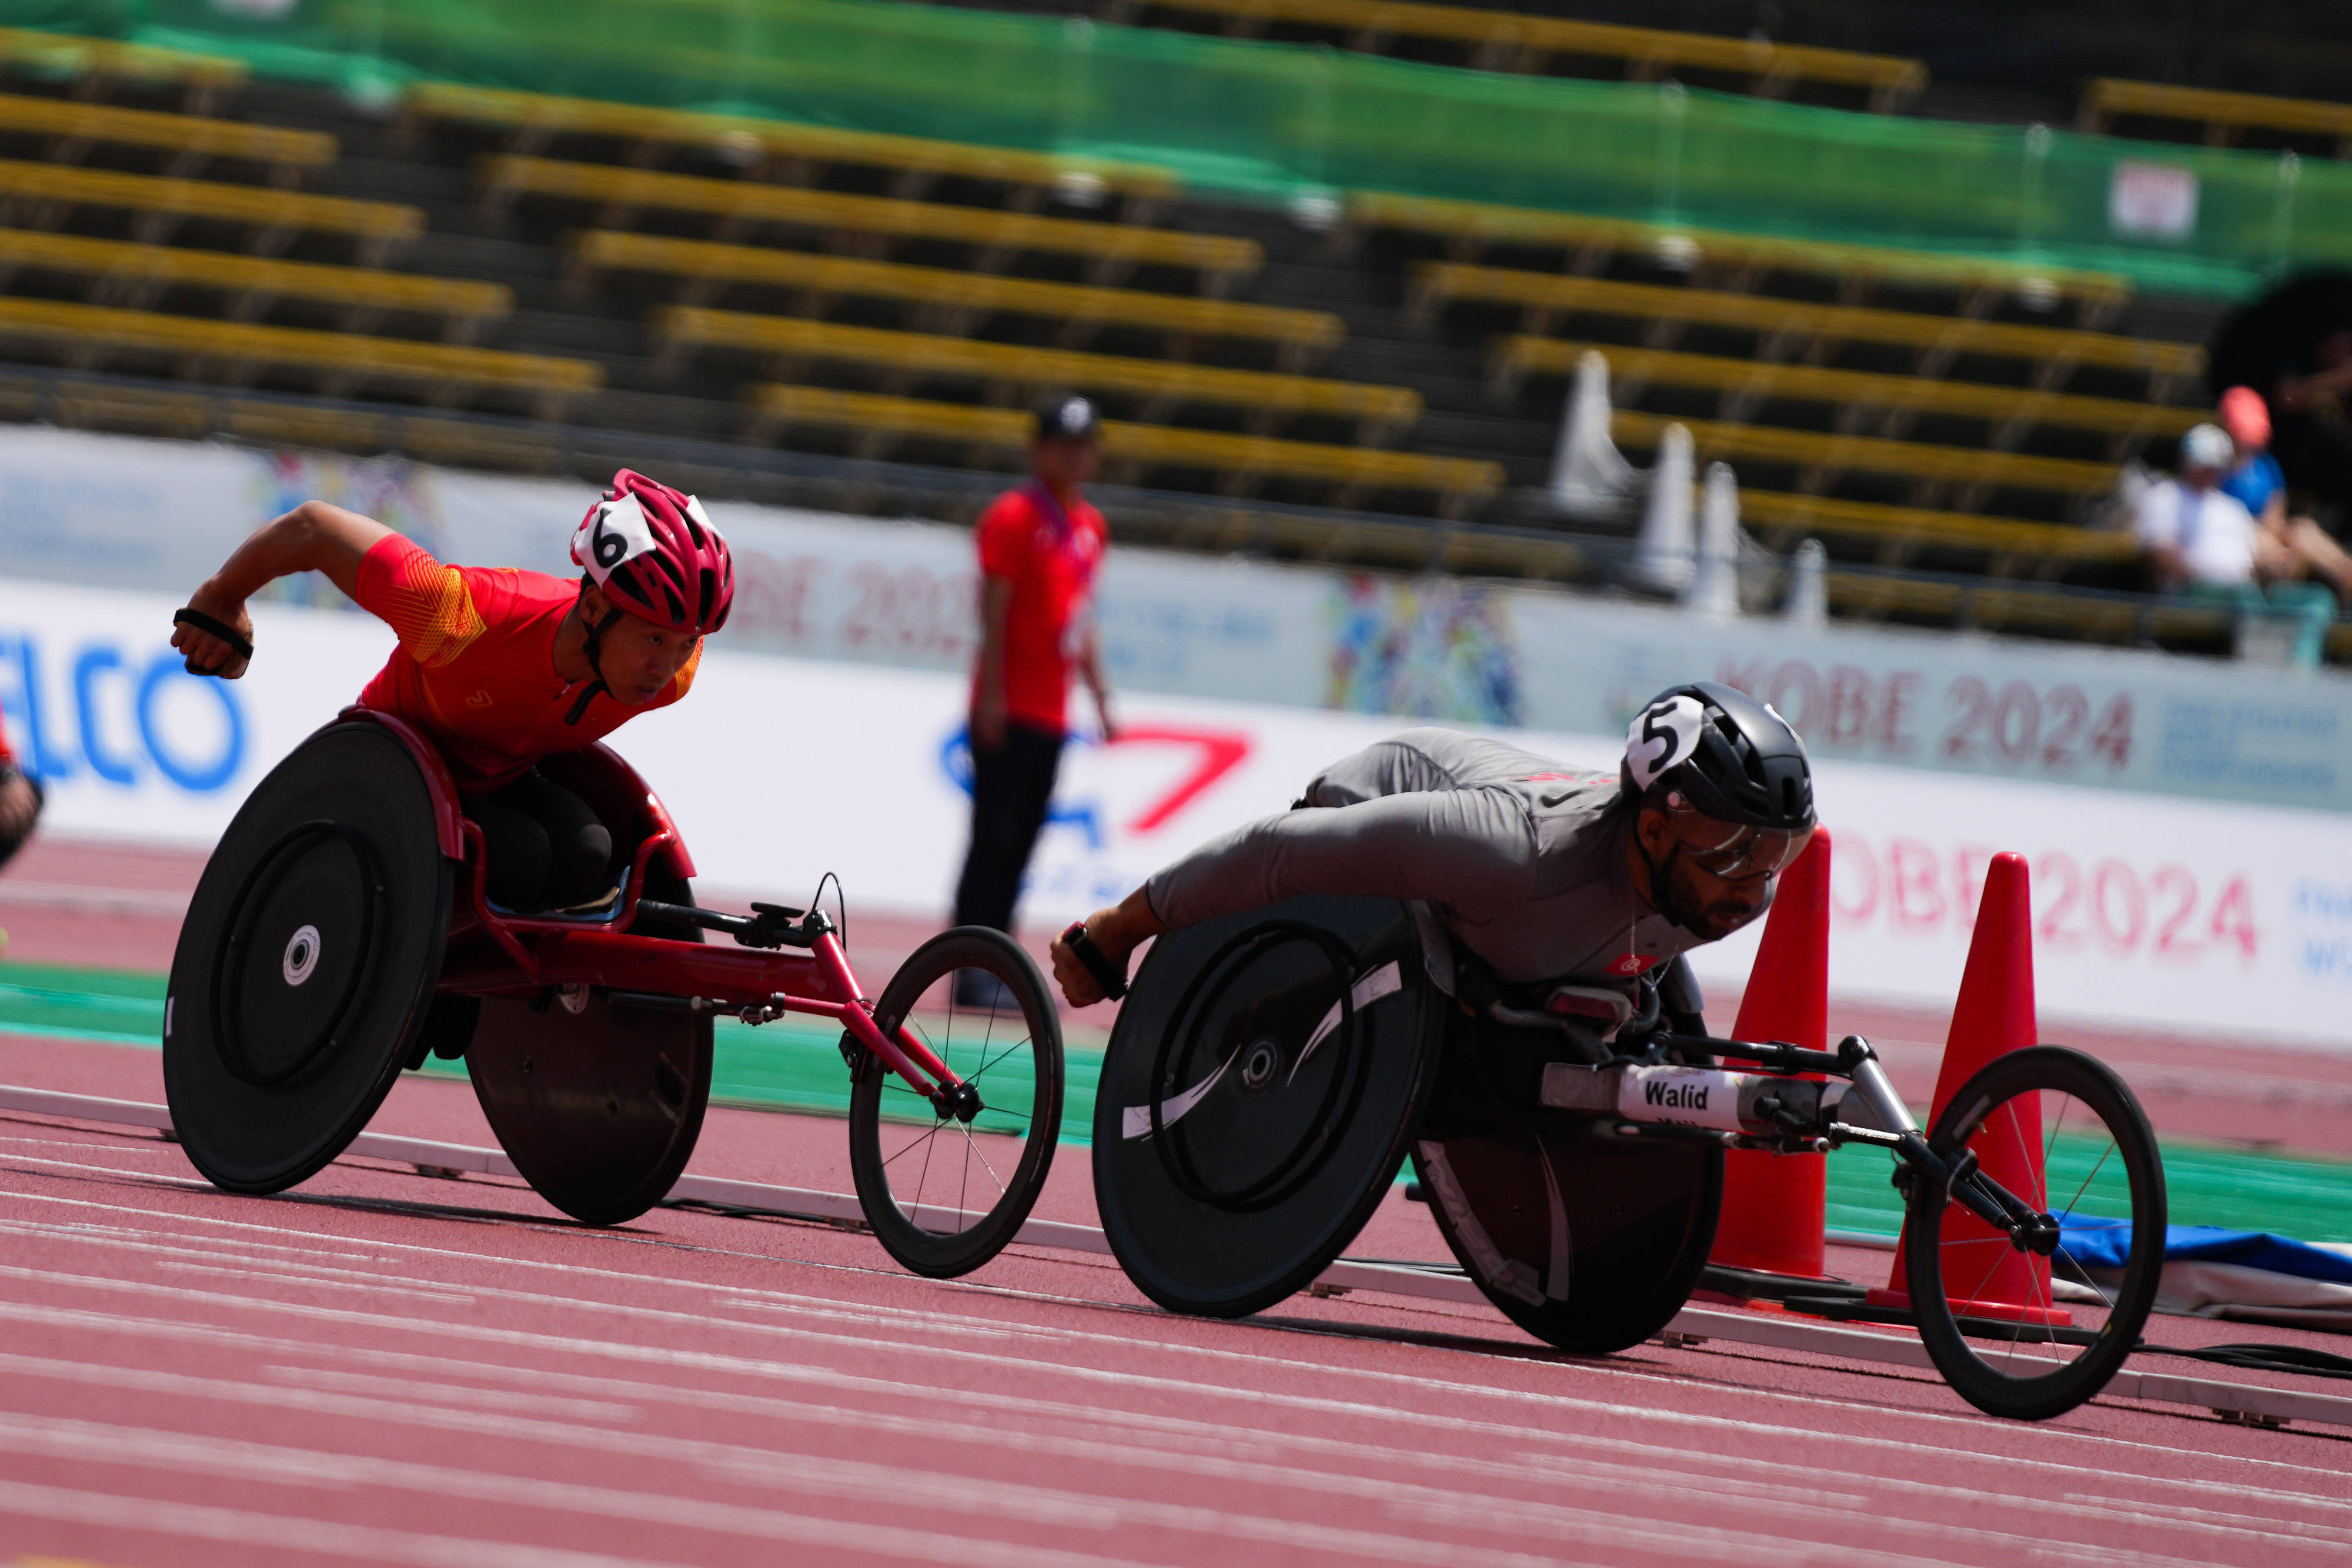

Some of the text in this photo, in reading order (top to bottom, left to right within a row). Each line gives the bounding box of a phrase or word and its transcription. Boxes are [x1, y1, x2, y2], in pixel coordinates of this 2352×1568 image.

[593, 507, 629, 569] 6
[1642, 701, 1679, 774] 5
[1942, 676, 2136, 769] 2024
[1828, 830, 1999, 941] OBE
[2036, 850, 2259, 961] 2024
[1645, 1080, 1710, 1111] Walid
